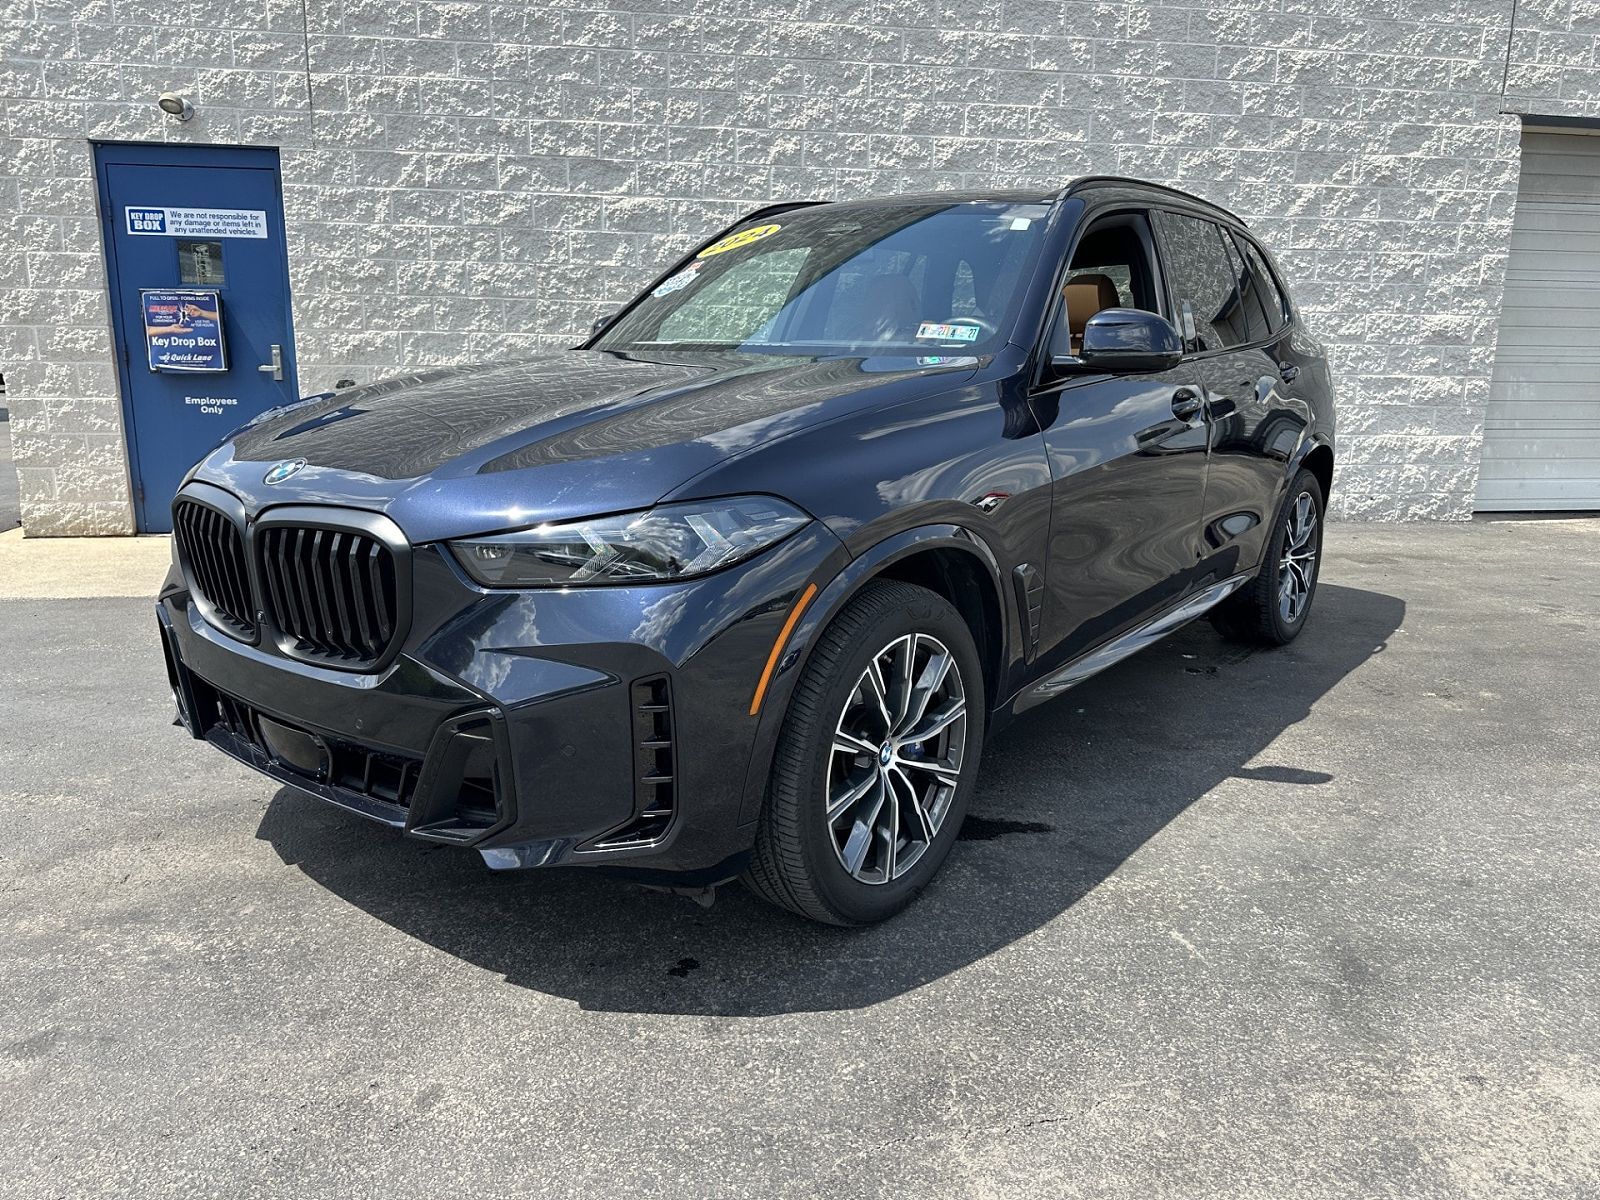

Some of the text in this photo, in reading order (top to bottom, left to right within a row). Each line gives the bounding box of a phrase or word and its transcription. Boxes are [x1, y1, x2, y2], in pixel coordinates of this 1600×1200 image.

[130, 212, 164, 221] KEY DROP
[169, 210, 182, 219] We
[208, 213, 248, 221] responsible
[249, 213, 260, 221] for
[134, 220, 162, 231] BOX
[184, 219, 211, 228] damage
[221, 220, 241, 228] items
[241, 220, 254, 228] left
[254, 221, 262, 229] in
[188, 227, 227, 235] unattended
[151, 336, 217, 349] Key Drop Box
[170, 353, 192, 361] Quick
[185, 396, 238, 406] Employees
[200, 405, 224, 415] Only
